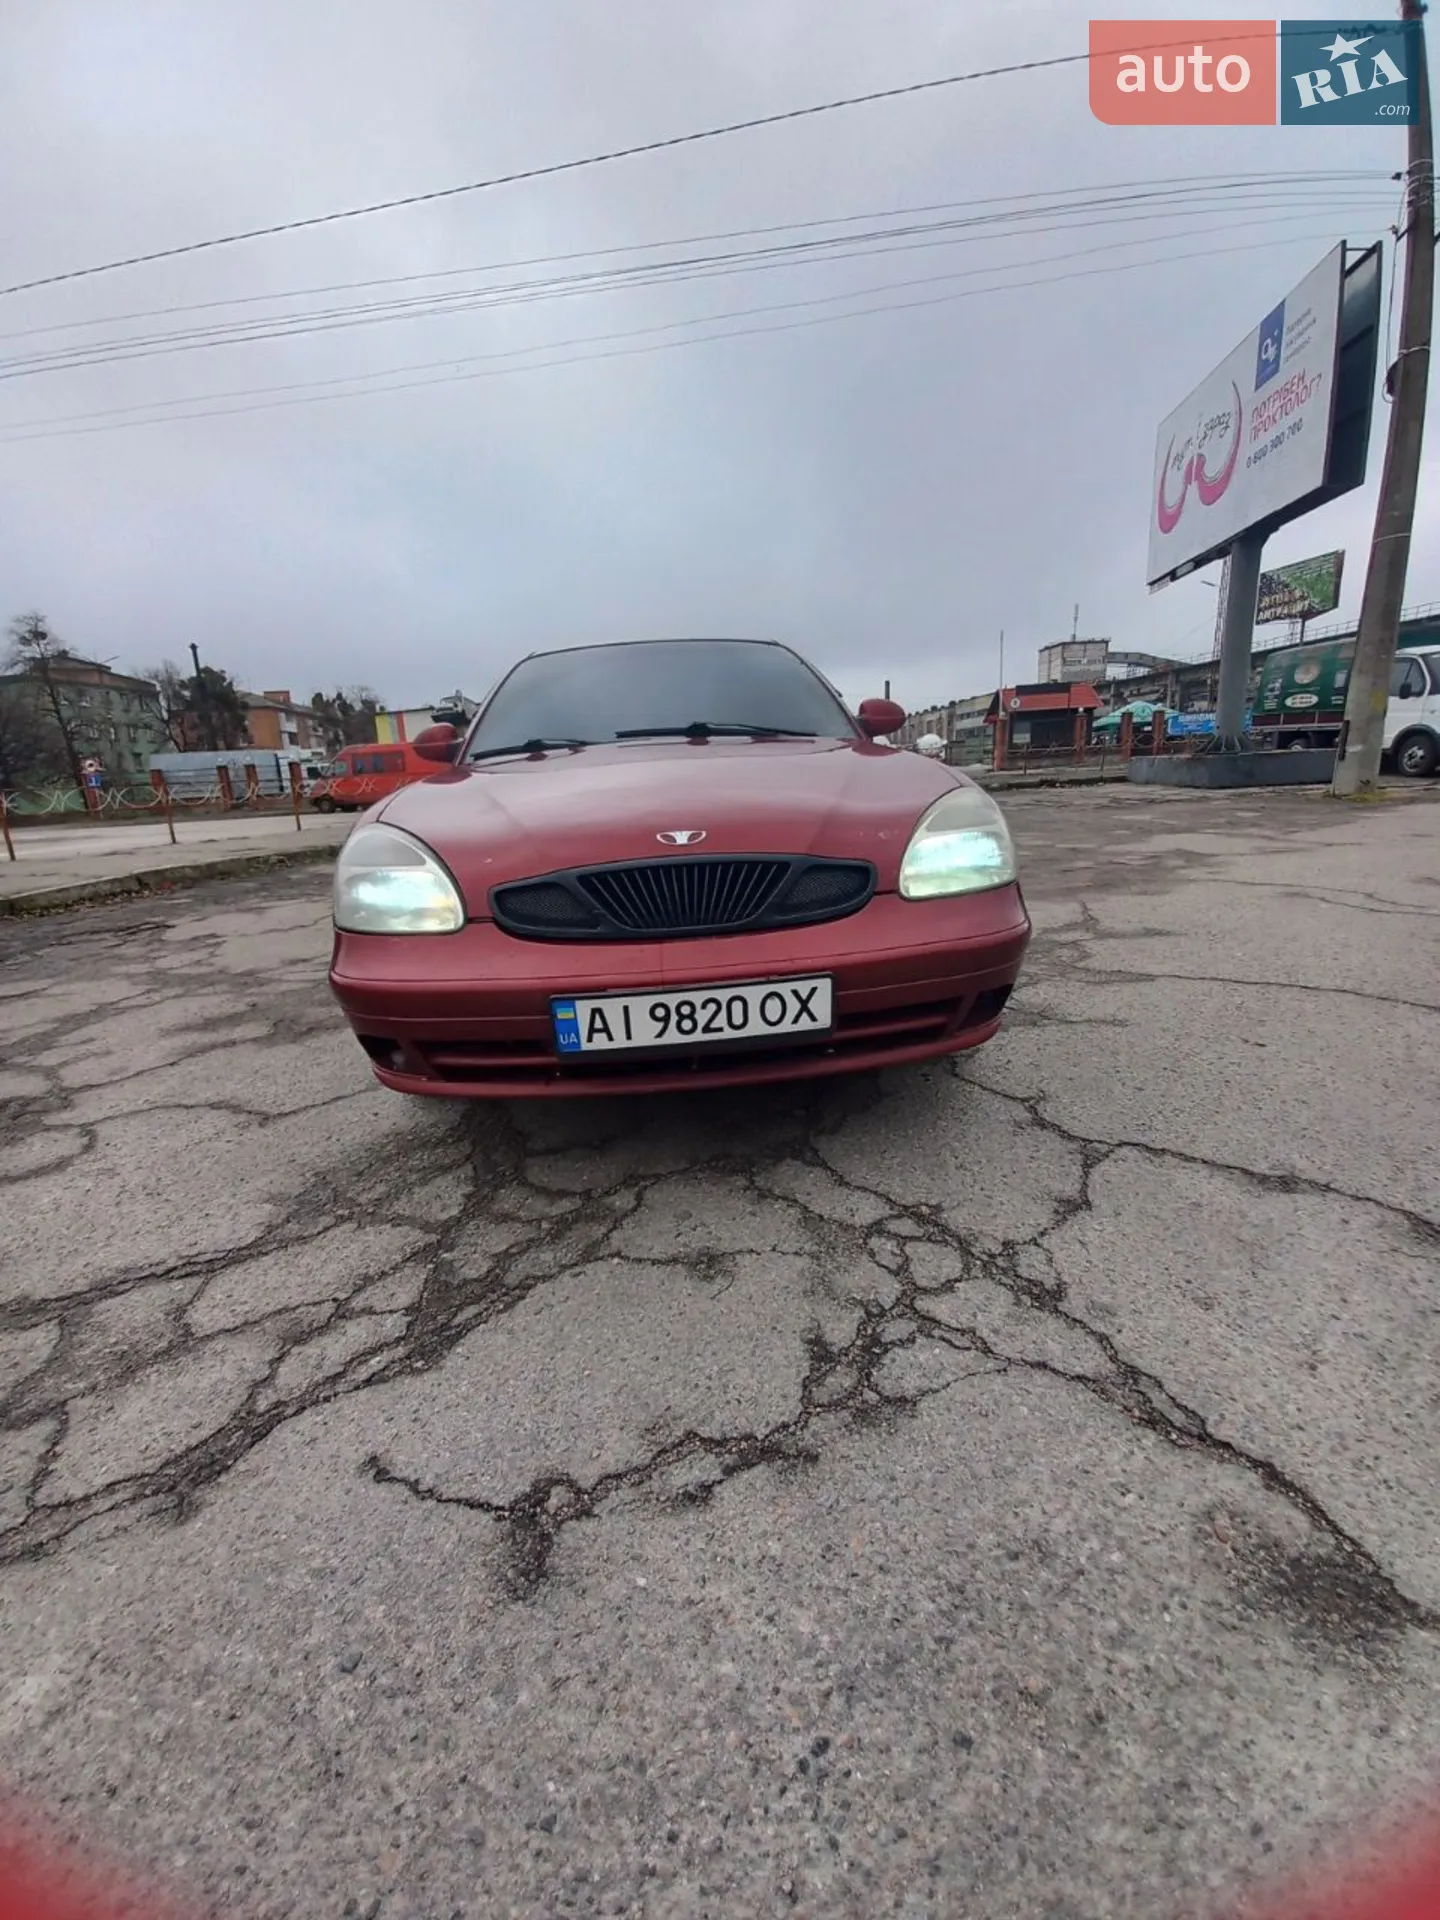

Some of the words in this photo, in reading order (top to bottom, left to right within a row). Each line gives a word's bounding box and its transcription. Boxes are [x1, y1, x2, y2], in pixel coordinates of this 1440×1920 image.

[1250, 371, 1323, 444] ПРОКТОЛОГ?
[1252, 367, 1306, 424] ПОТРІБЕН
[560, 1032, 579, 1046] UA
[586, 1004, 633, 1043] AI
[649, 994, 750, 1039] 9820
[759, 986, 819, 1027] OX
